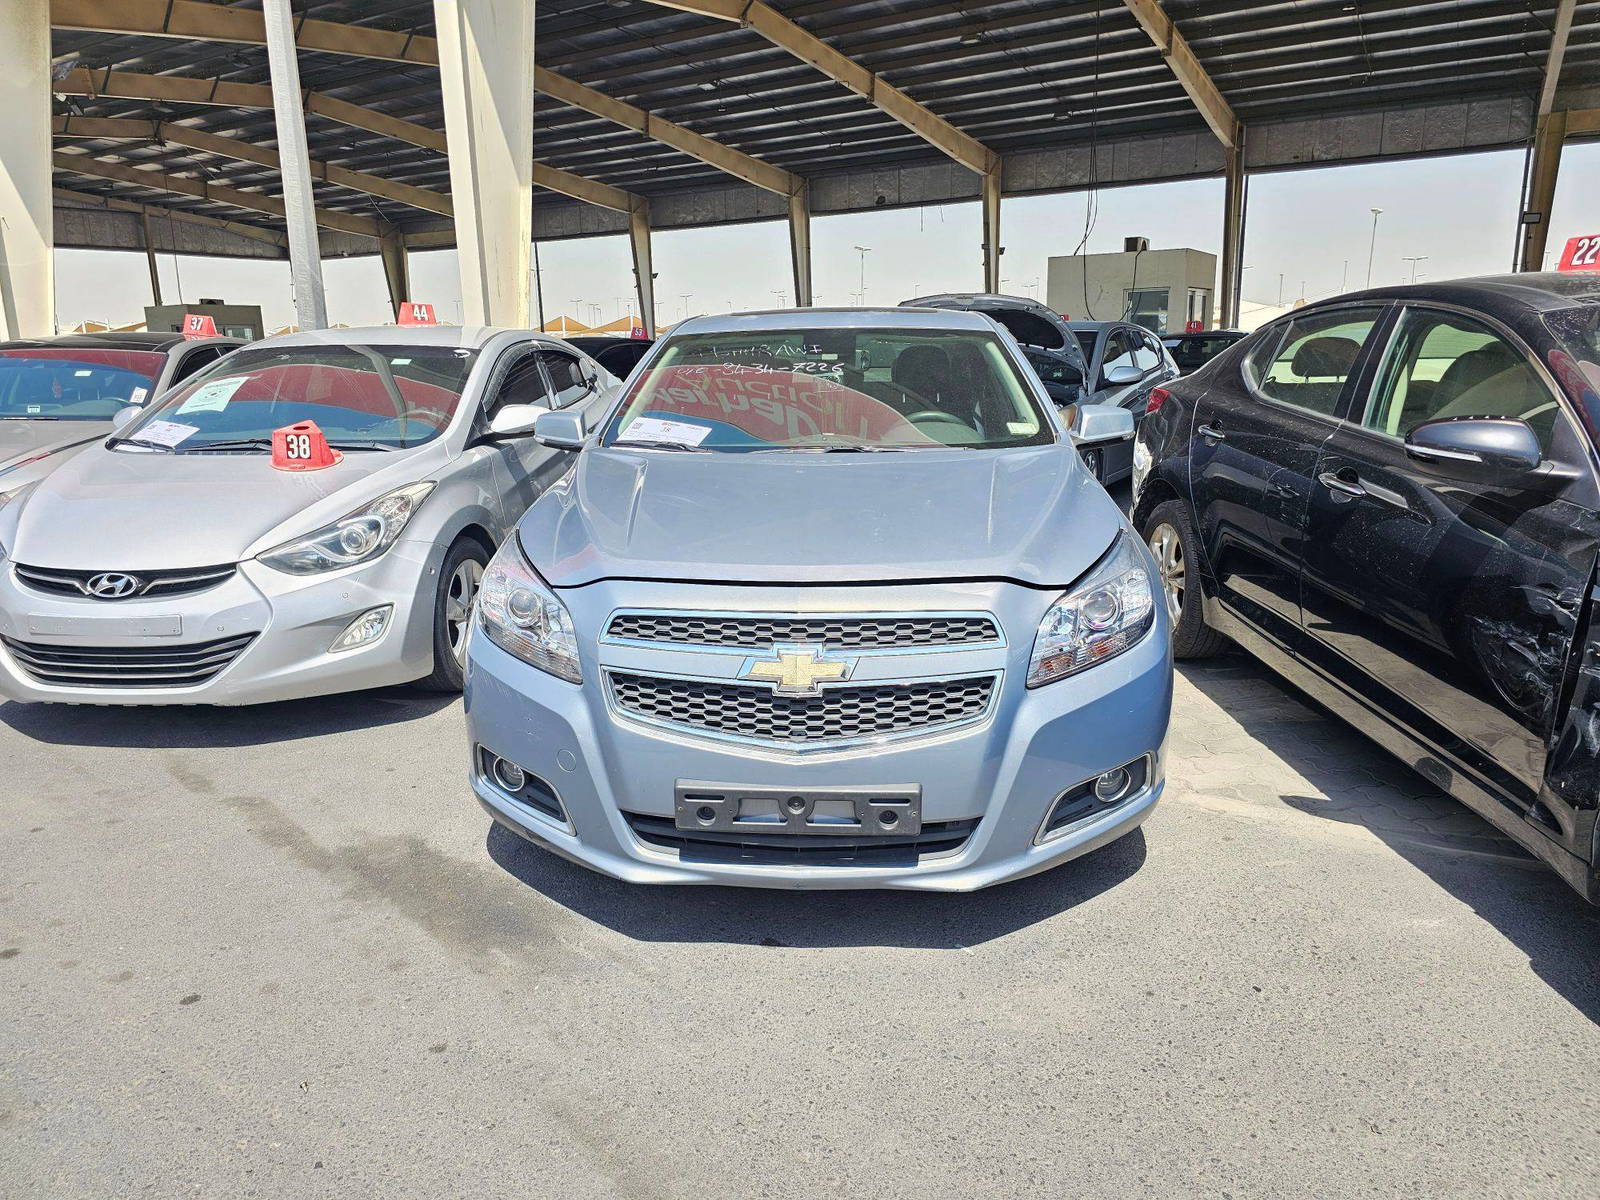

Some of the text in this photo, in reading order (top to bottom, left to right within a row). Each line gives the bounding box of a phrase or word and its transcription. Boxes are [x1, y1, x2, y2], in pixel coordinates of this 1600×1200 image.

[1571, 237, 1600, 266] 22
[413, 304, 429, 321] 44
[190, 317, 204, 331] 37
[286, 434, 311, 459] 38
